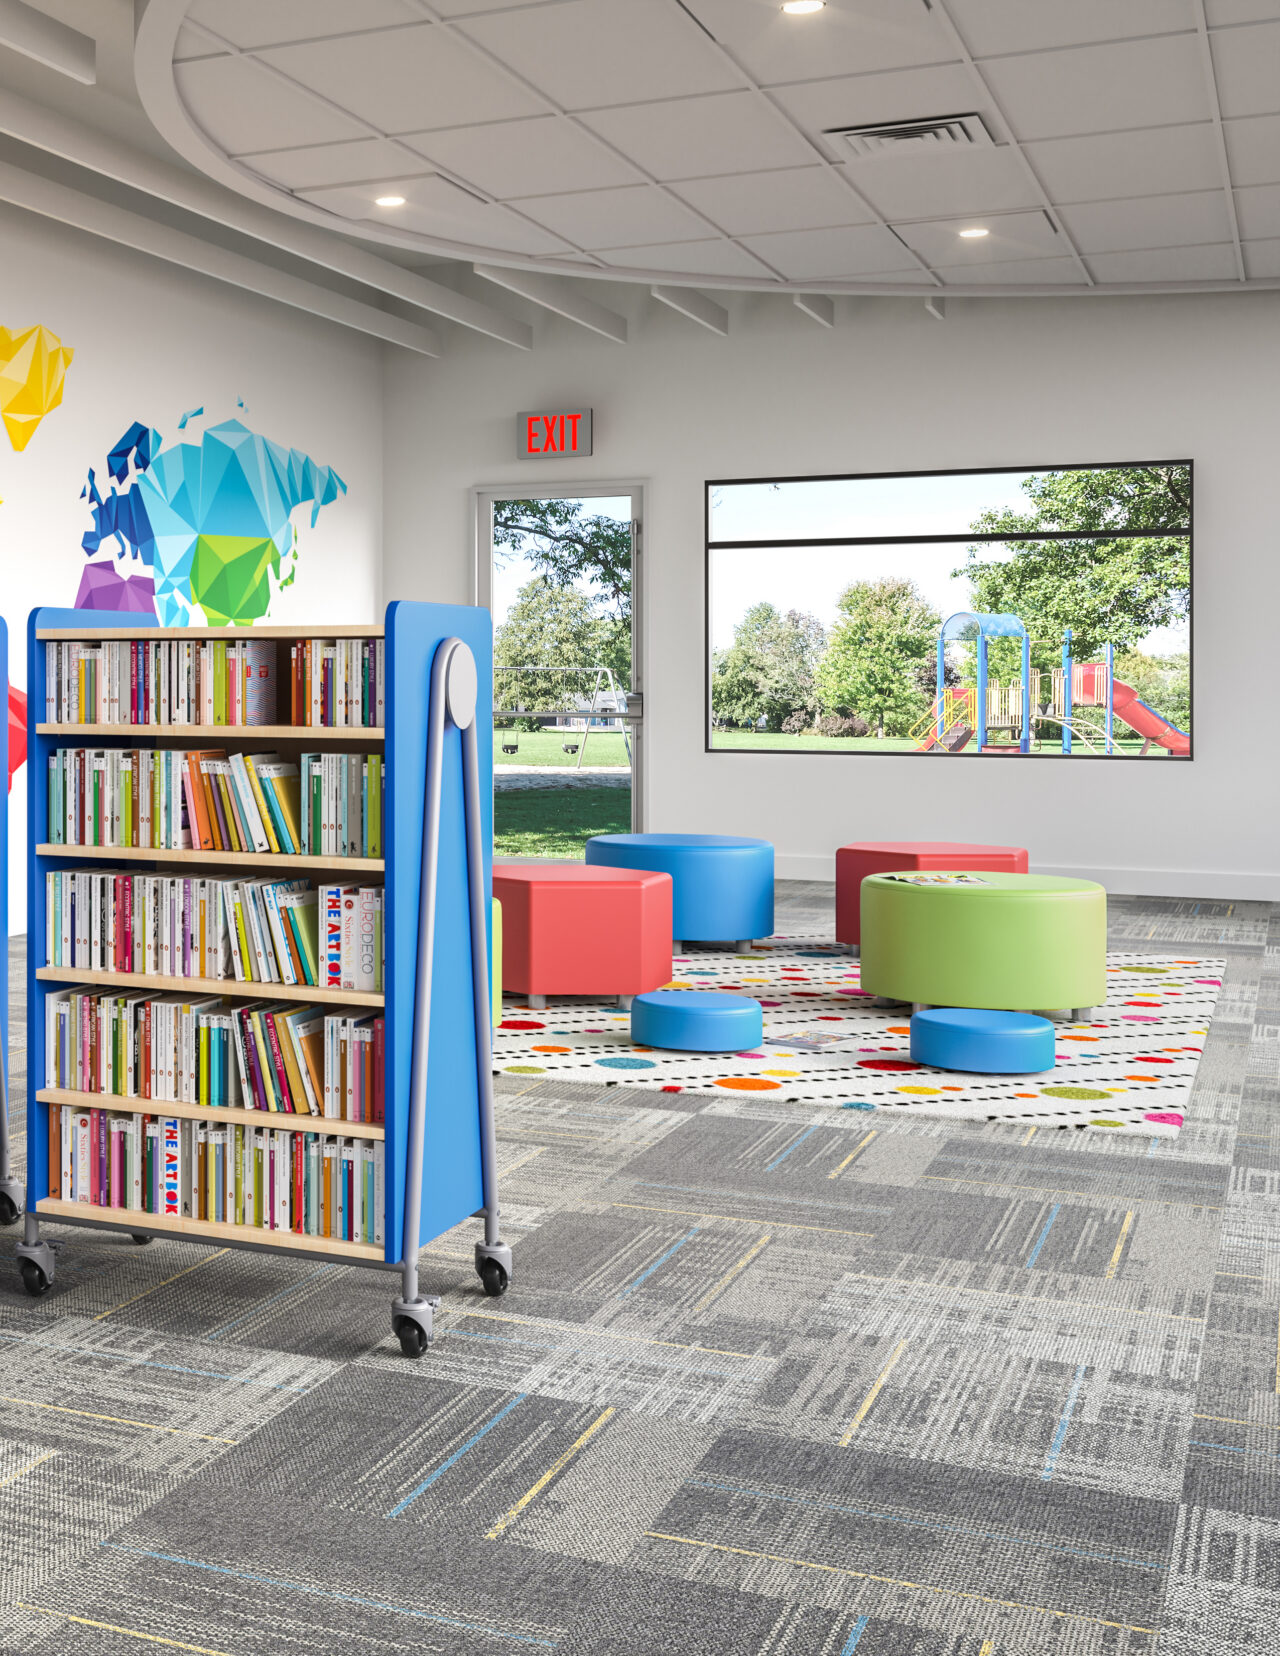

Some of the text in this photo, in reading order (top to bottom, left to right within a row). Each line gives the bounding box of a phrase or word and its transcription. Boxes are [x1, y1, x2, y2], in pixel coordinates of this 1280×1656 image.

[527, 413, 582, 453] EXIT
[328, 888, 341, 987] THE ART BOOK
[344, 916, 354, 945] Sixties
[361, 891, 374, 975] EURODECO
[268, 1028, 279, 1055] ECCENTRIC
[274, 1055, 282, 1070] STYLE
[80, 1133, 88, 1160] Sixties
[165, 1119, 178, 1215] THE ART BOOK
